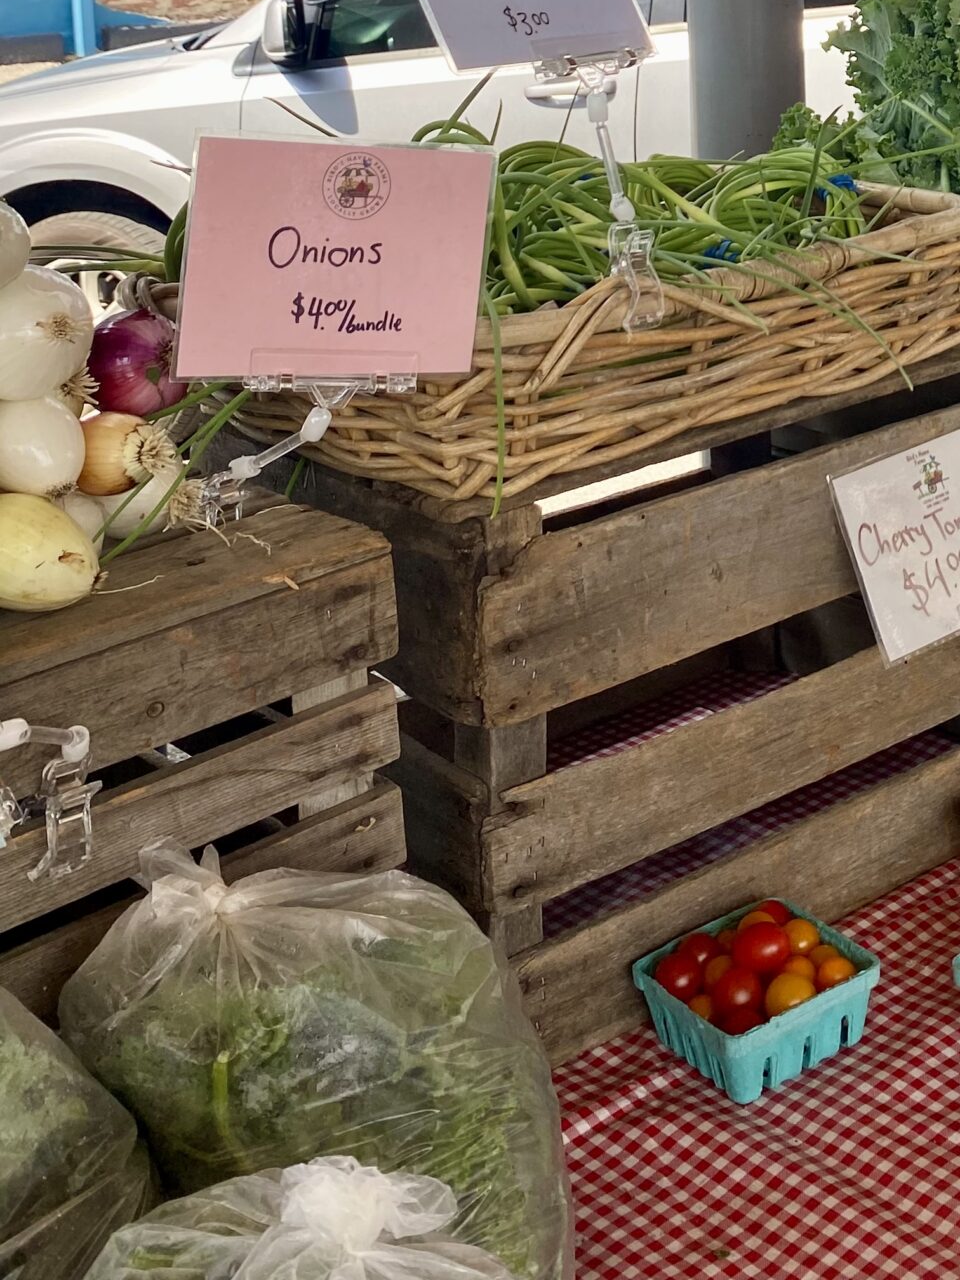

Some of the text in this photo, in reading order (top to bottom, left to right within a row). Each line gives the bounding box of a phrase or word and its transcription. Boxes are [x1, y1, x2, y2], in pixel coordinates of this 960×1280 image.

[503, 6, 550, 35] $3.00
[268, 226, 382, 268] Onions
[857, 521, 933, 566] Cherry
